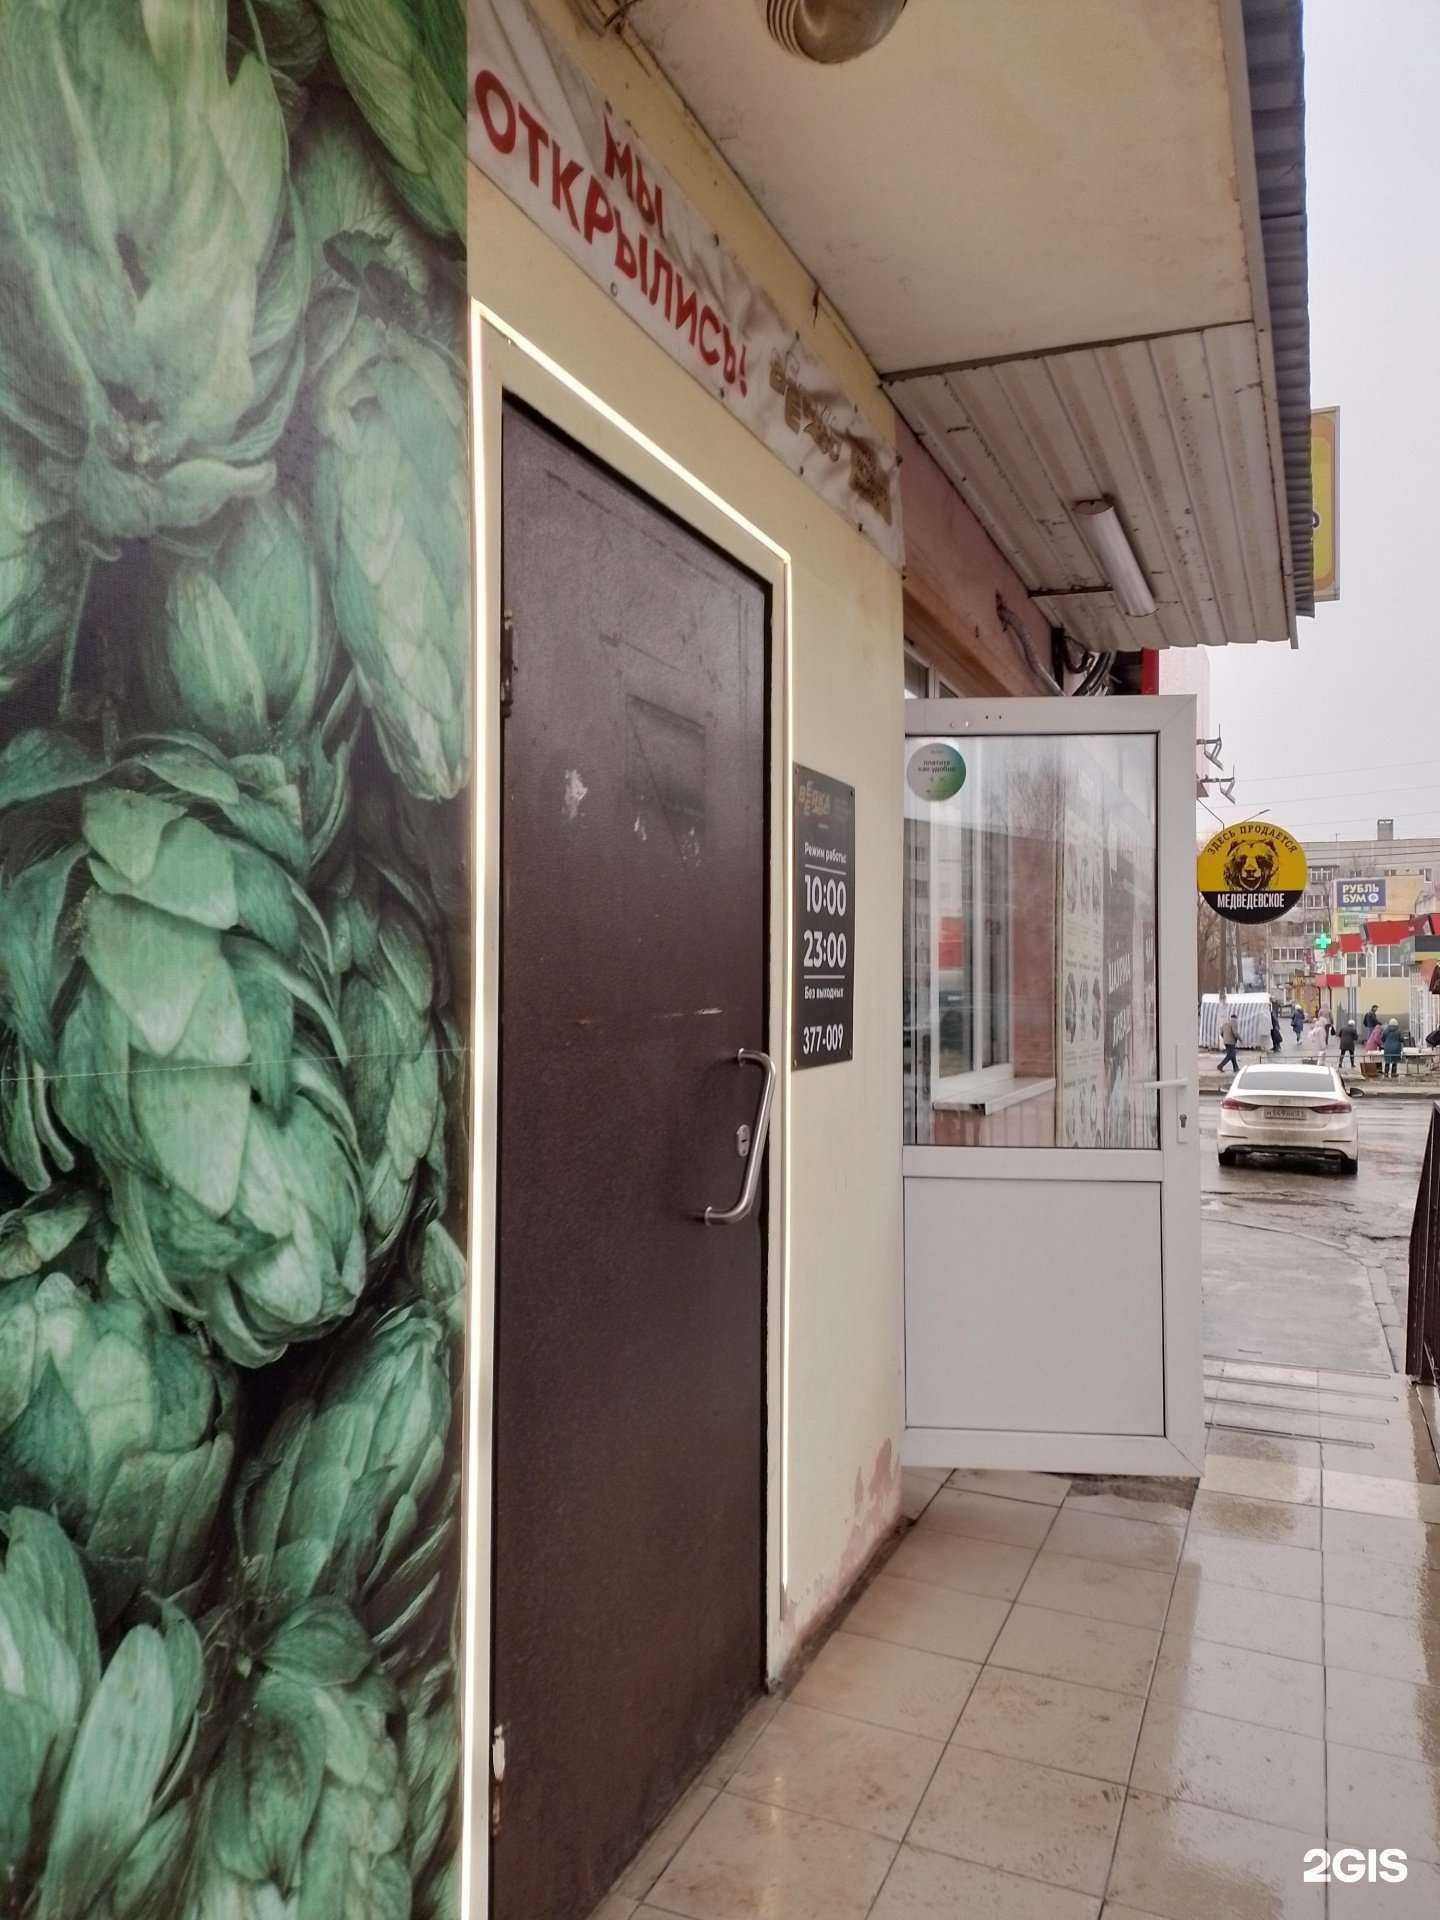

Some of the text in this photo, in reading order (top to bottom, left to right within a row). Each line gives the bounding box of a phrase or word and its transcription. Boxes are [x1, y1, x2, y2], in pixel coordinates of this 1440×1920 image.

[604, 114, 664, 239] МЫ
[474, 69, 748, 398] ОТКРЫЛИСЬ!
[804, 842, 825, 858] Режим
[1207, 825, 1297, 856] ЗДЕСЬ ПРОДАЕТСЯ
[804, 874, 847, 917] 10:00
[1342, 883, 1380, 894] РУБЛЬ
[1342, 893, 1367, 904] БУМ
[1217, 892, 1285, 911] МЕДВЕДЕВСКОЕ
[803, 929, 847, 969] 23:00
[804, 985, 816, 1000] Без
